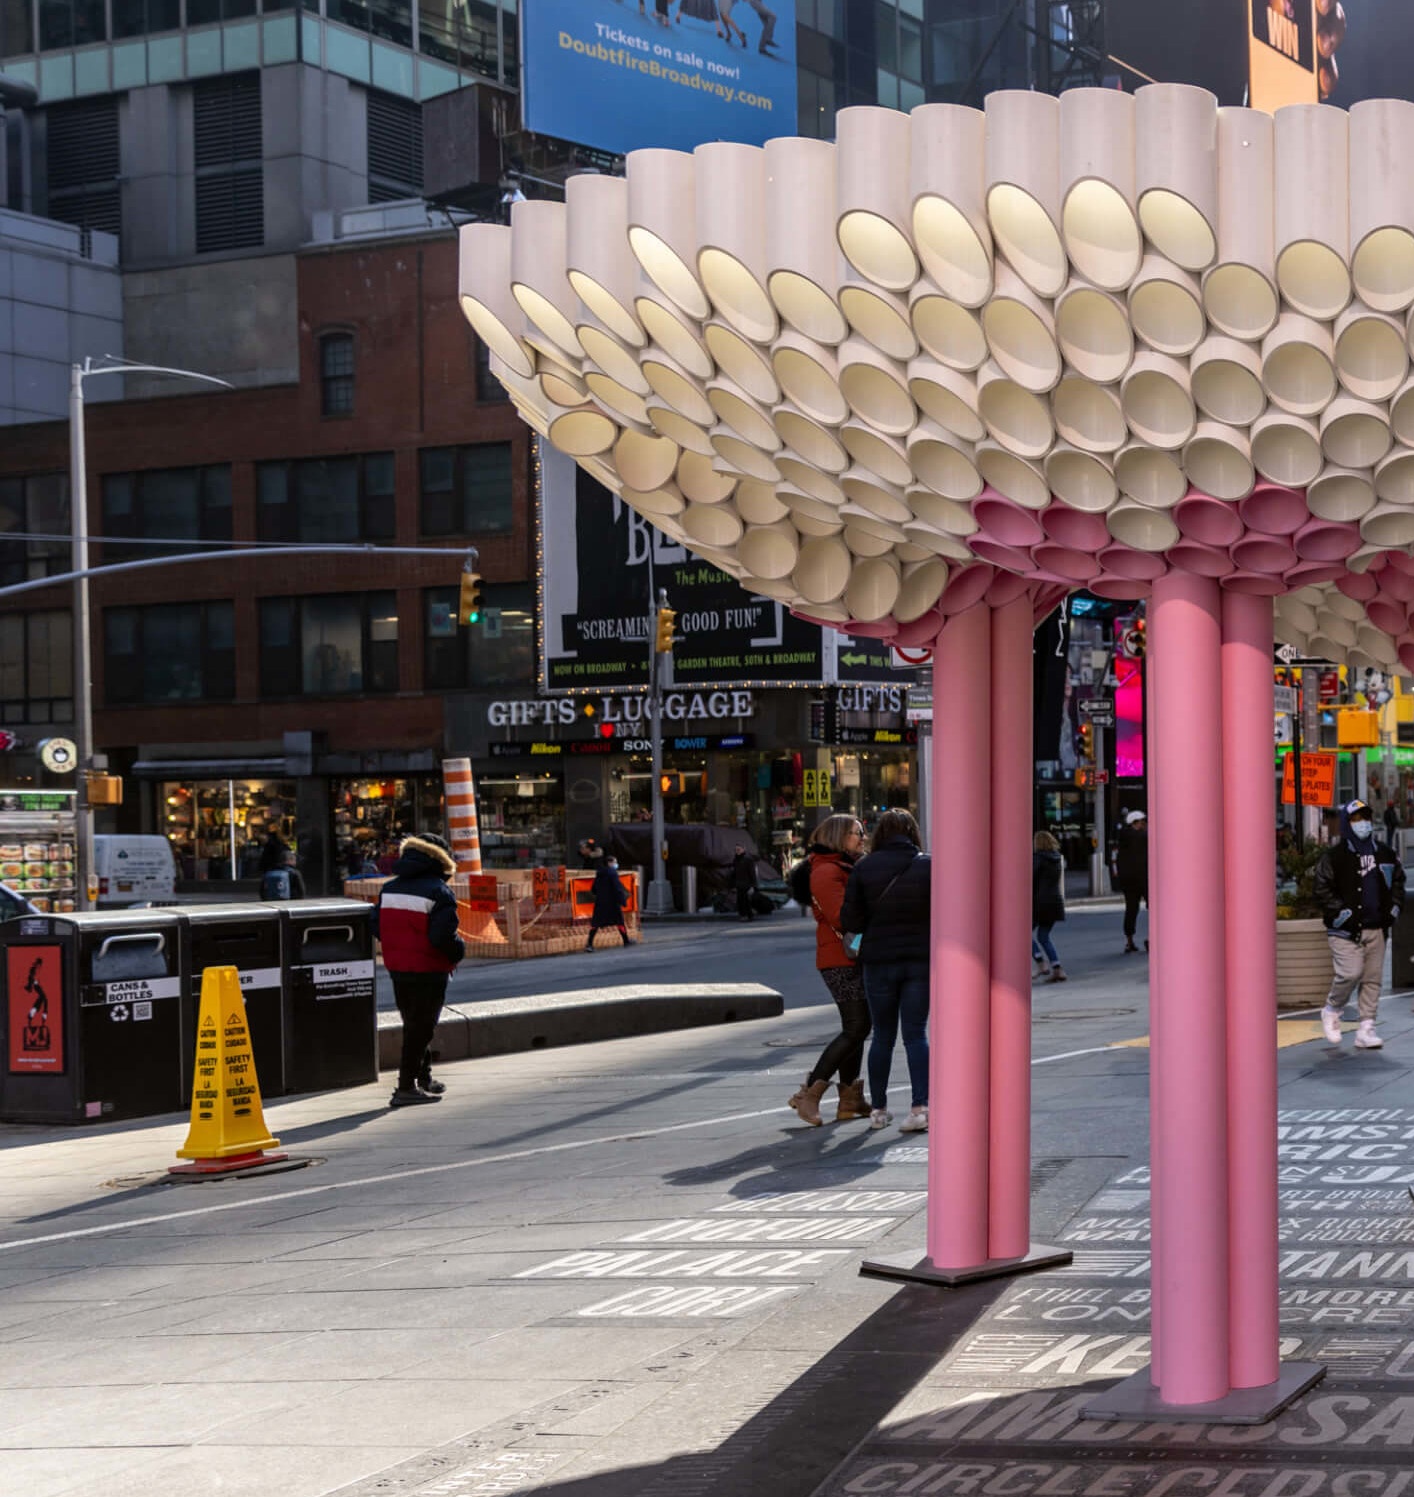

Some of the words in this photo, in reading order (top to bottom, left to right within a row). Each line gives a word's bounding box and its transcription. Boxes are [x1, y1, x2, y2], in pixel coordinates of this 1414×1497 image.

[595, 22, 650, 52] Tickets
[653, 43, 672, 60] on
[675, 48, 703, 71] sale
[707, 60, 740, 80] now!
[558, 31, 773, 111] DoubtfireBroadway.com
[675, 570, 696, 585] The
[698, 568, 733, 584] Music
[577, 615, 650, 640] “SCREAMIN
[681, 612, 720, 632] GOOD
[586, 661, 628, 675] BROADWAY
[676, 656, 708, 671] GARDEN
[773, 651, 817, 665] BROADWAY
[487, 697, 578, 726] GIFTS
[601, 690, 755, 724] LUGGAGE
[837, 687, 902, 713] GIFTS
[530, 742, 562, 756] Nikon
[805, 770, 815, 800] ATM
[819, 770, 830, 800] ATM
[1305, 780, 1331, 792] PLATES
[318, 967, 349, 978] TRASH
[110, 982, 139, 993] CANS
[139, 981, 149, 990] &
[108, 990, 154, 1003] BOTTLES
[198, 1057, 218, 1067] SAFETY
[224, 1054, 251, 1066] SAFETY
[228, 1063, 249, 1075] FIRST
[200, 1067, 216, 1077] FIRST
[235, 1078, 245, 1087] LA
[623, 1217, 897, 1242] LYCEUM
[510, 1249, 858, 1278] PALACE
[576, 1286, 801, 1317] CORT
[842, 1462, 1155, 1497] CIRCLE
